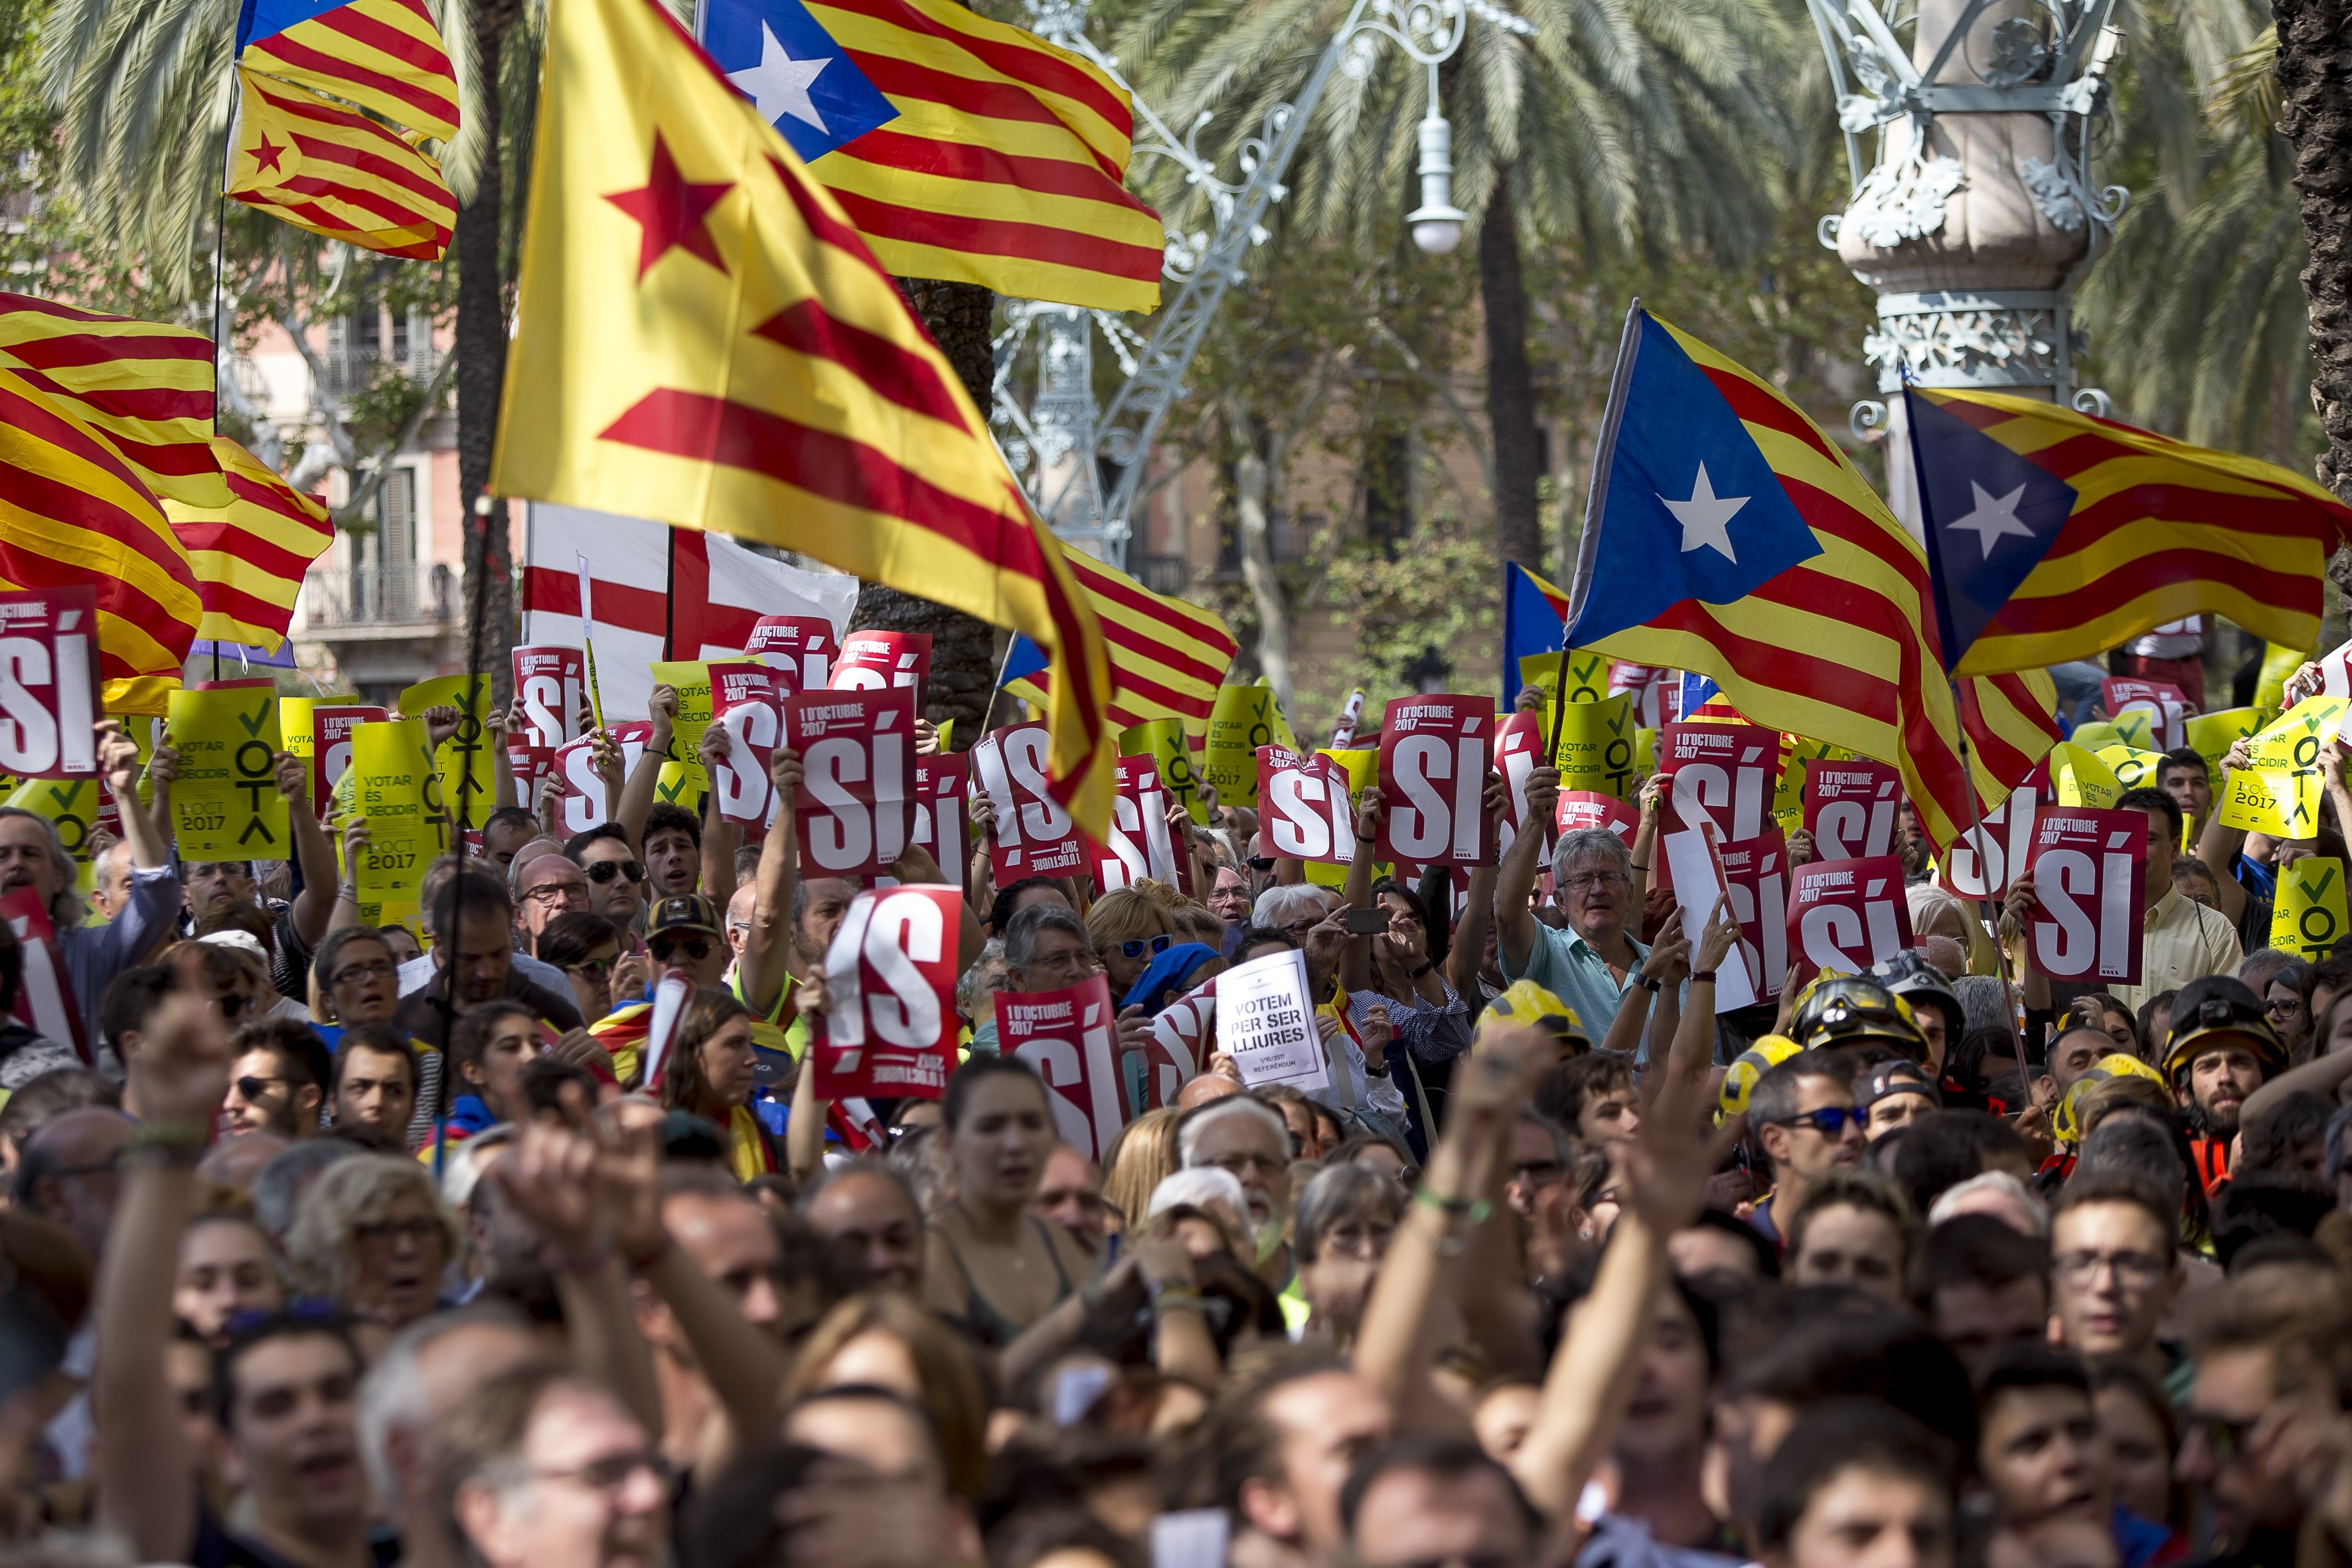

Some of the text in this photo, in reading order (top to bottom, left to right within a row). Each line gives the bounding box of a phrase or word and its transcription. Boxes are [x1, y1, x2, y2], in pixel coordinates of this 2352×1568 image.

[0, 602, 48, 619] OCTUBRE
[752, 626, 799, 638] 1 D'OCTUBRE
[750, 637, 768, 649] 2017
[520, 656, 524, 666] 1
[520, 666, 535, 676] 2017
[722, 674, 772, 688] 1 D'OCTUBRE
[0, 610, 96, 773] SÍ
[725, 688, 747, 702] 2017
[523, 664, 580, 748] SÍ
[799, 703, 865, 722] 1 D'OCTUBRE
[1396, 705, 1454, 719] 1 D'OCTUBRE
[324, 718, 327, 729] 1
[801, 722, 826, 737] 2017
[1395, 718, 1418, 731] 2017
[325, 728, 341, 740] 2017
[1212, 730, 1222, 738] ÉS
[1676, 733, 1734, 748] 1 D'OCTUBRE
[176, 741, 224, 752] VOTAR
[288, 745, 299, 753] ÉS
[1210, 740, 1245, 749] DECIDIR
[1559, 742, 1597, 752] VOTAR
[1559, 751, 1572, 762] ÉS
[1675, 746, 1698, 759] 2017
[1269, 756, 1291, 768] 2017
[1559, 763, 1601, 773] DECIDIR
[2251, 757, 2288, 768] ECIDIR
[180, 768, 230, 779] DECIDIR
[1208, 775, 1241, 785] 2017
[1820, 771, 1873, 785] 1 D'OCTUBRE
[365, 775, 412, 787] VOTAR
[566, 731, 643, 833] SÍ
[803, 710, 904, 870] SÍ
[1389, 717, 1484, 860] SÍ
[1672, 746, 1764, 842] SÍ
[1818, 785, 1841, 797] 2017
[2082, 781, 2112, 798] VOTAR
[365, 790, 382, 802] ÉS
[2086, 790, 2097, 802] ÉS
[2235, 793, 2278, 810] 2017
[366, 804, 419, 817] DECIDIR
[1269, 767, 1356, 862] SÍ
[1774, 807, 1797, 819] IDIR
[182, 816, 226, 830] 2017
[1561, 813, 1576, 825] 2017
[1815, 781, 1895, 862] SÍ
[2042, 818, 2098, 833] 1 D'OCTUBRE
[2039, 831, 2061, 844] 2017
[1061, 840, 1079, 854] 2017
[368, 854, 416, 870] 2017
[1720, 850, 1751, 866] TUBRE
[1800, 871, 1855, 890] 1 D'OCTUBRE
[1799, 888, 1820, 903] 2017
[2033, 831, 2132, 976] SÍ
[1801, 878, 1901, 976] SÍ
[2270, 935, 2296, 948] ECIDIR
[824, 892, 943, 1074] SÍ
[1007, 1001, 1073, 1019] 1 D'OCTUBRE
[1235, 992, 1293, 1016] VOTEM
[1008, 1020, 1034, 1036] 2017
[1231, 1010, 1302, 1035] PER SER
[1233, 1027, 1305, 1054] LLIURES
[1014, 1002, 1123, 1163] SÍ
